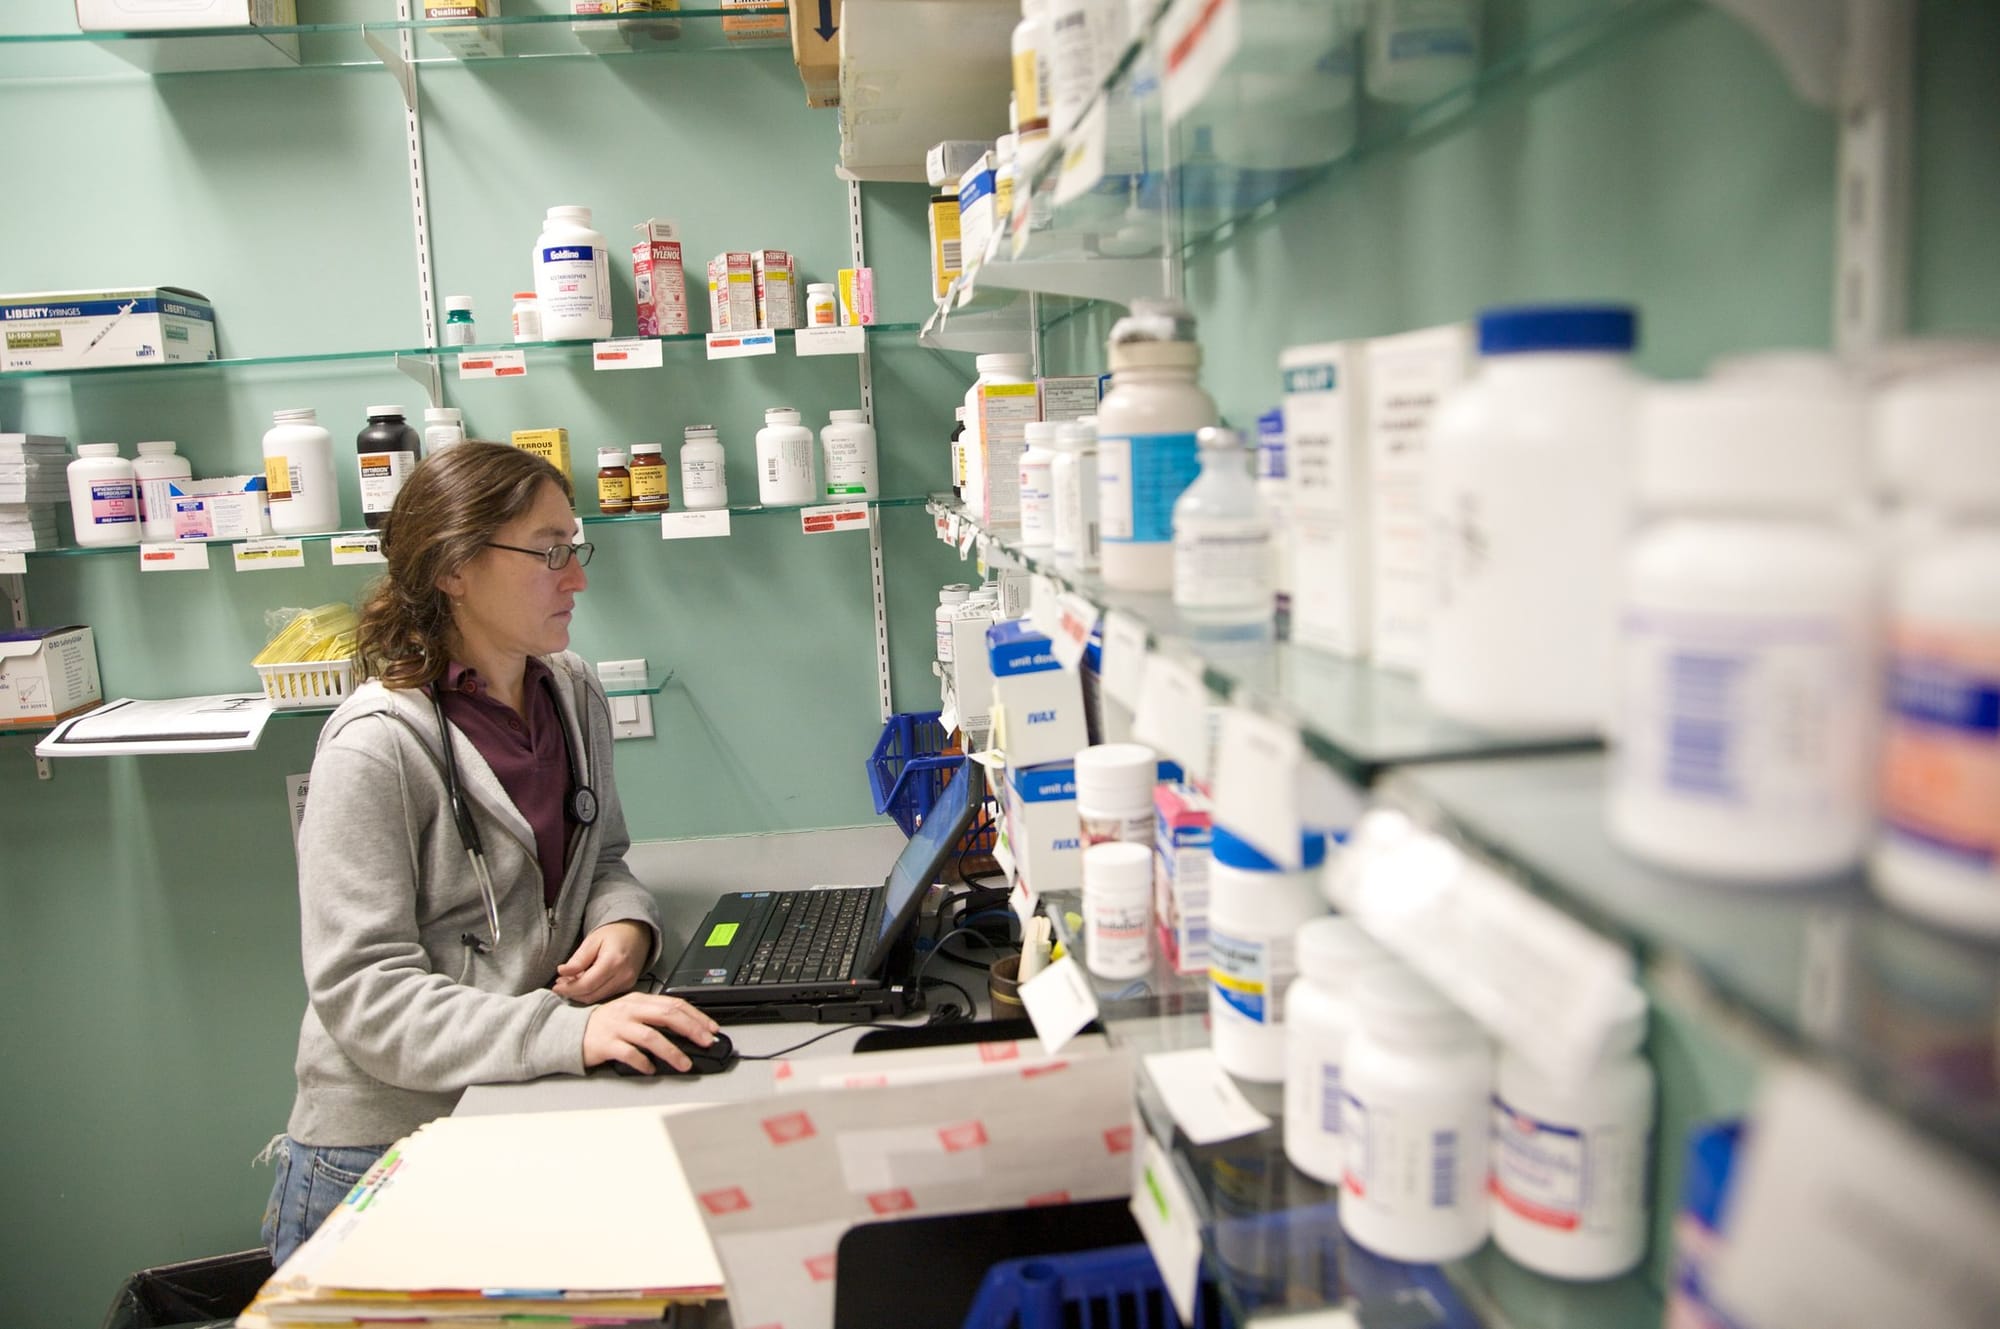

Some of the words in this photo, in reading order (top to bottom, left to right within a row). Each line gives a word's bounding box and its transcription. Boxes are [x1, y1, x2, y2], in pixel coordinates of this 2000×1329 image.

[652, 248, 681, 260] TYLENOL
[5, 307, 49, 319] LIBERTY
[48, 307, 81, 317] SYRINGES
[163, 303, 186, 315] LIBERTY
[516, 441, 553, 449] FERROUS
[1008, 655, 1032, 668] unit
[1028, 711, 1056, 724] IVAX
[1038, 783, 1061, 795] unit
